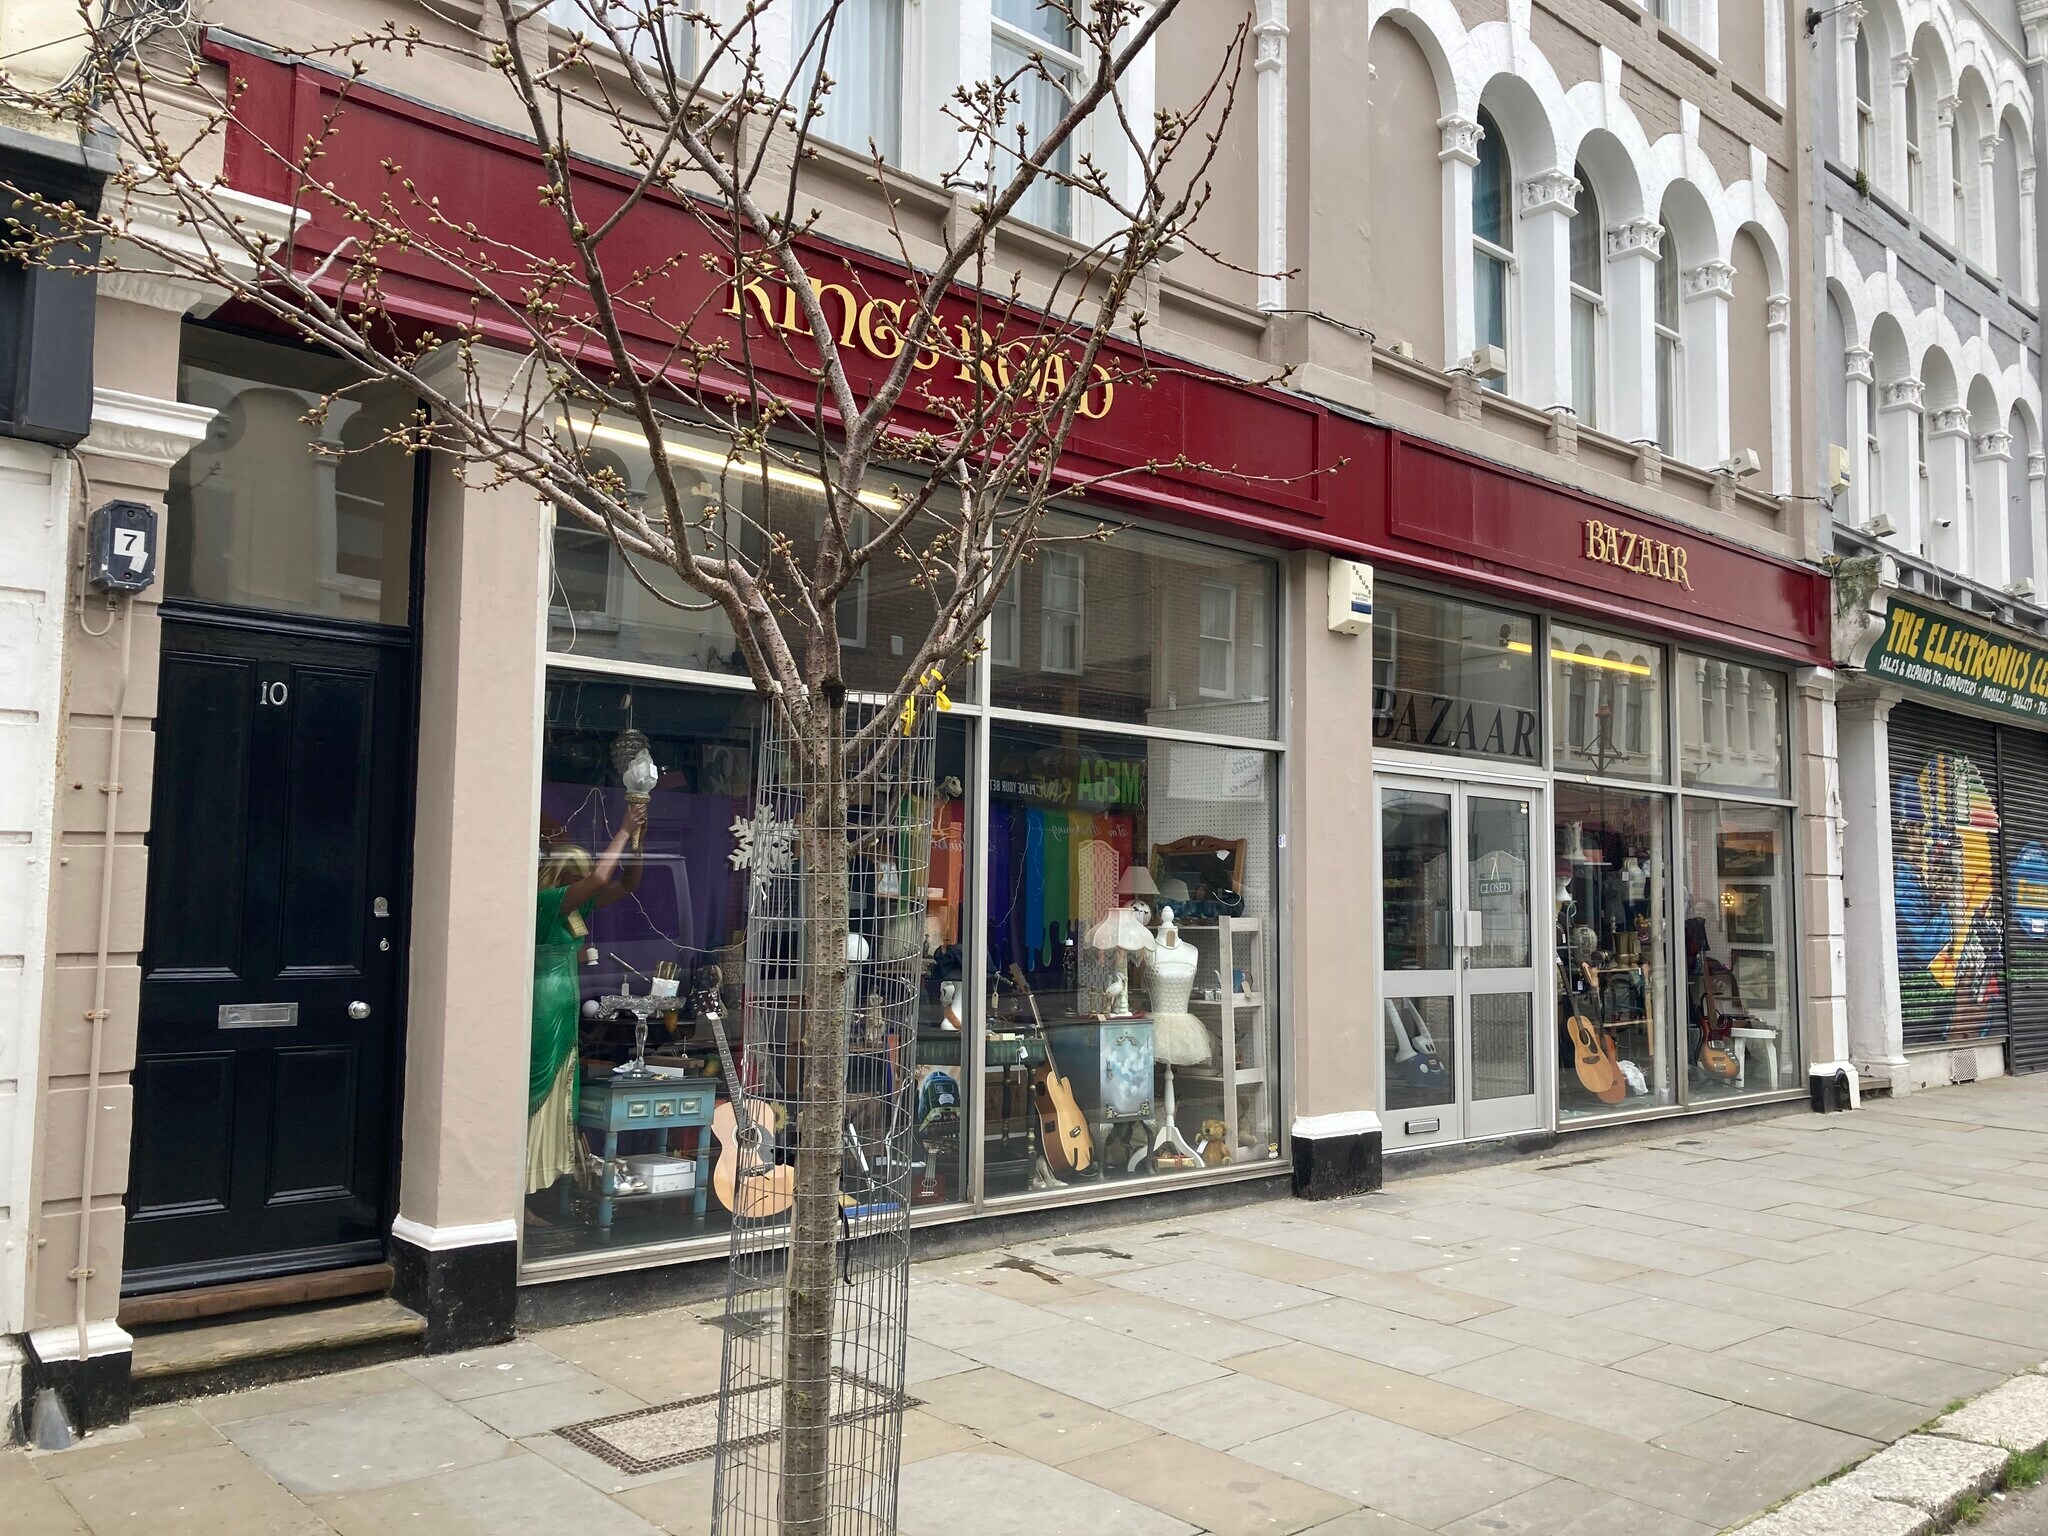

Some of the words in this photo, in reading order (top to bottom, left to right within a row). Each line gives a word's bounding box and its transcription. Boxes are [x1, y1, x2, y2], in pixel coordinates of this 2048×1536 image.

[954, 324, 1114, 419] ROAD
[123, 533, 138, 551] 7
[1586, 519, 1695, 592] BAZAAR
[1878, 654, 1899, 675] SALES
[1899, 662, 1906, 676] &
[1905, 661, 1933, 684] REPAIRS
[1932, 670, 1943, 687] TO:
[1942, 673, 1978, 696] COMPUTERS
[1981, 685, 2008, 704] MOBILES
[2011, 693, 2034, 712] TABLETS
[1886, 607, 1926, 658] THE
[1923, 622, 2030, 691] ELECTRONICS
[2029, 657, 2048, 698] CE
[260, 681, 288, 706] 10
[1372, 686, 1536, 758] BAZAAR
[1479, 882, 1511, 894] CLOSED
